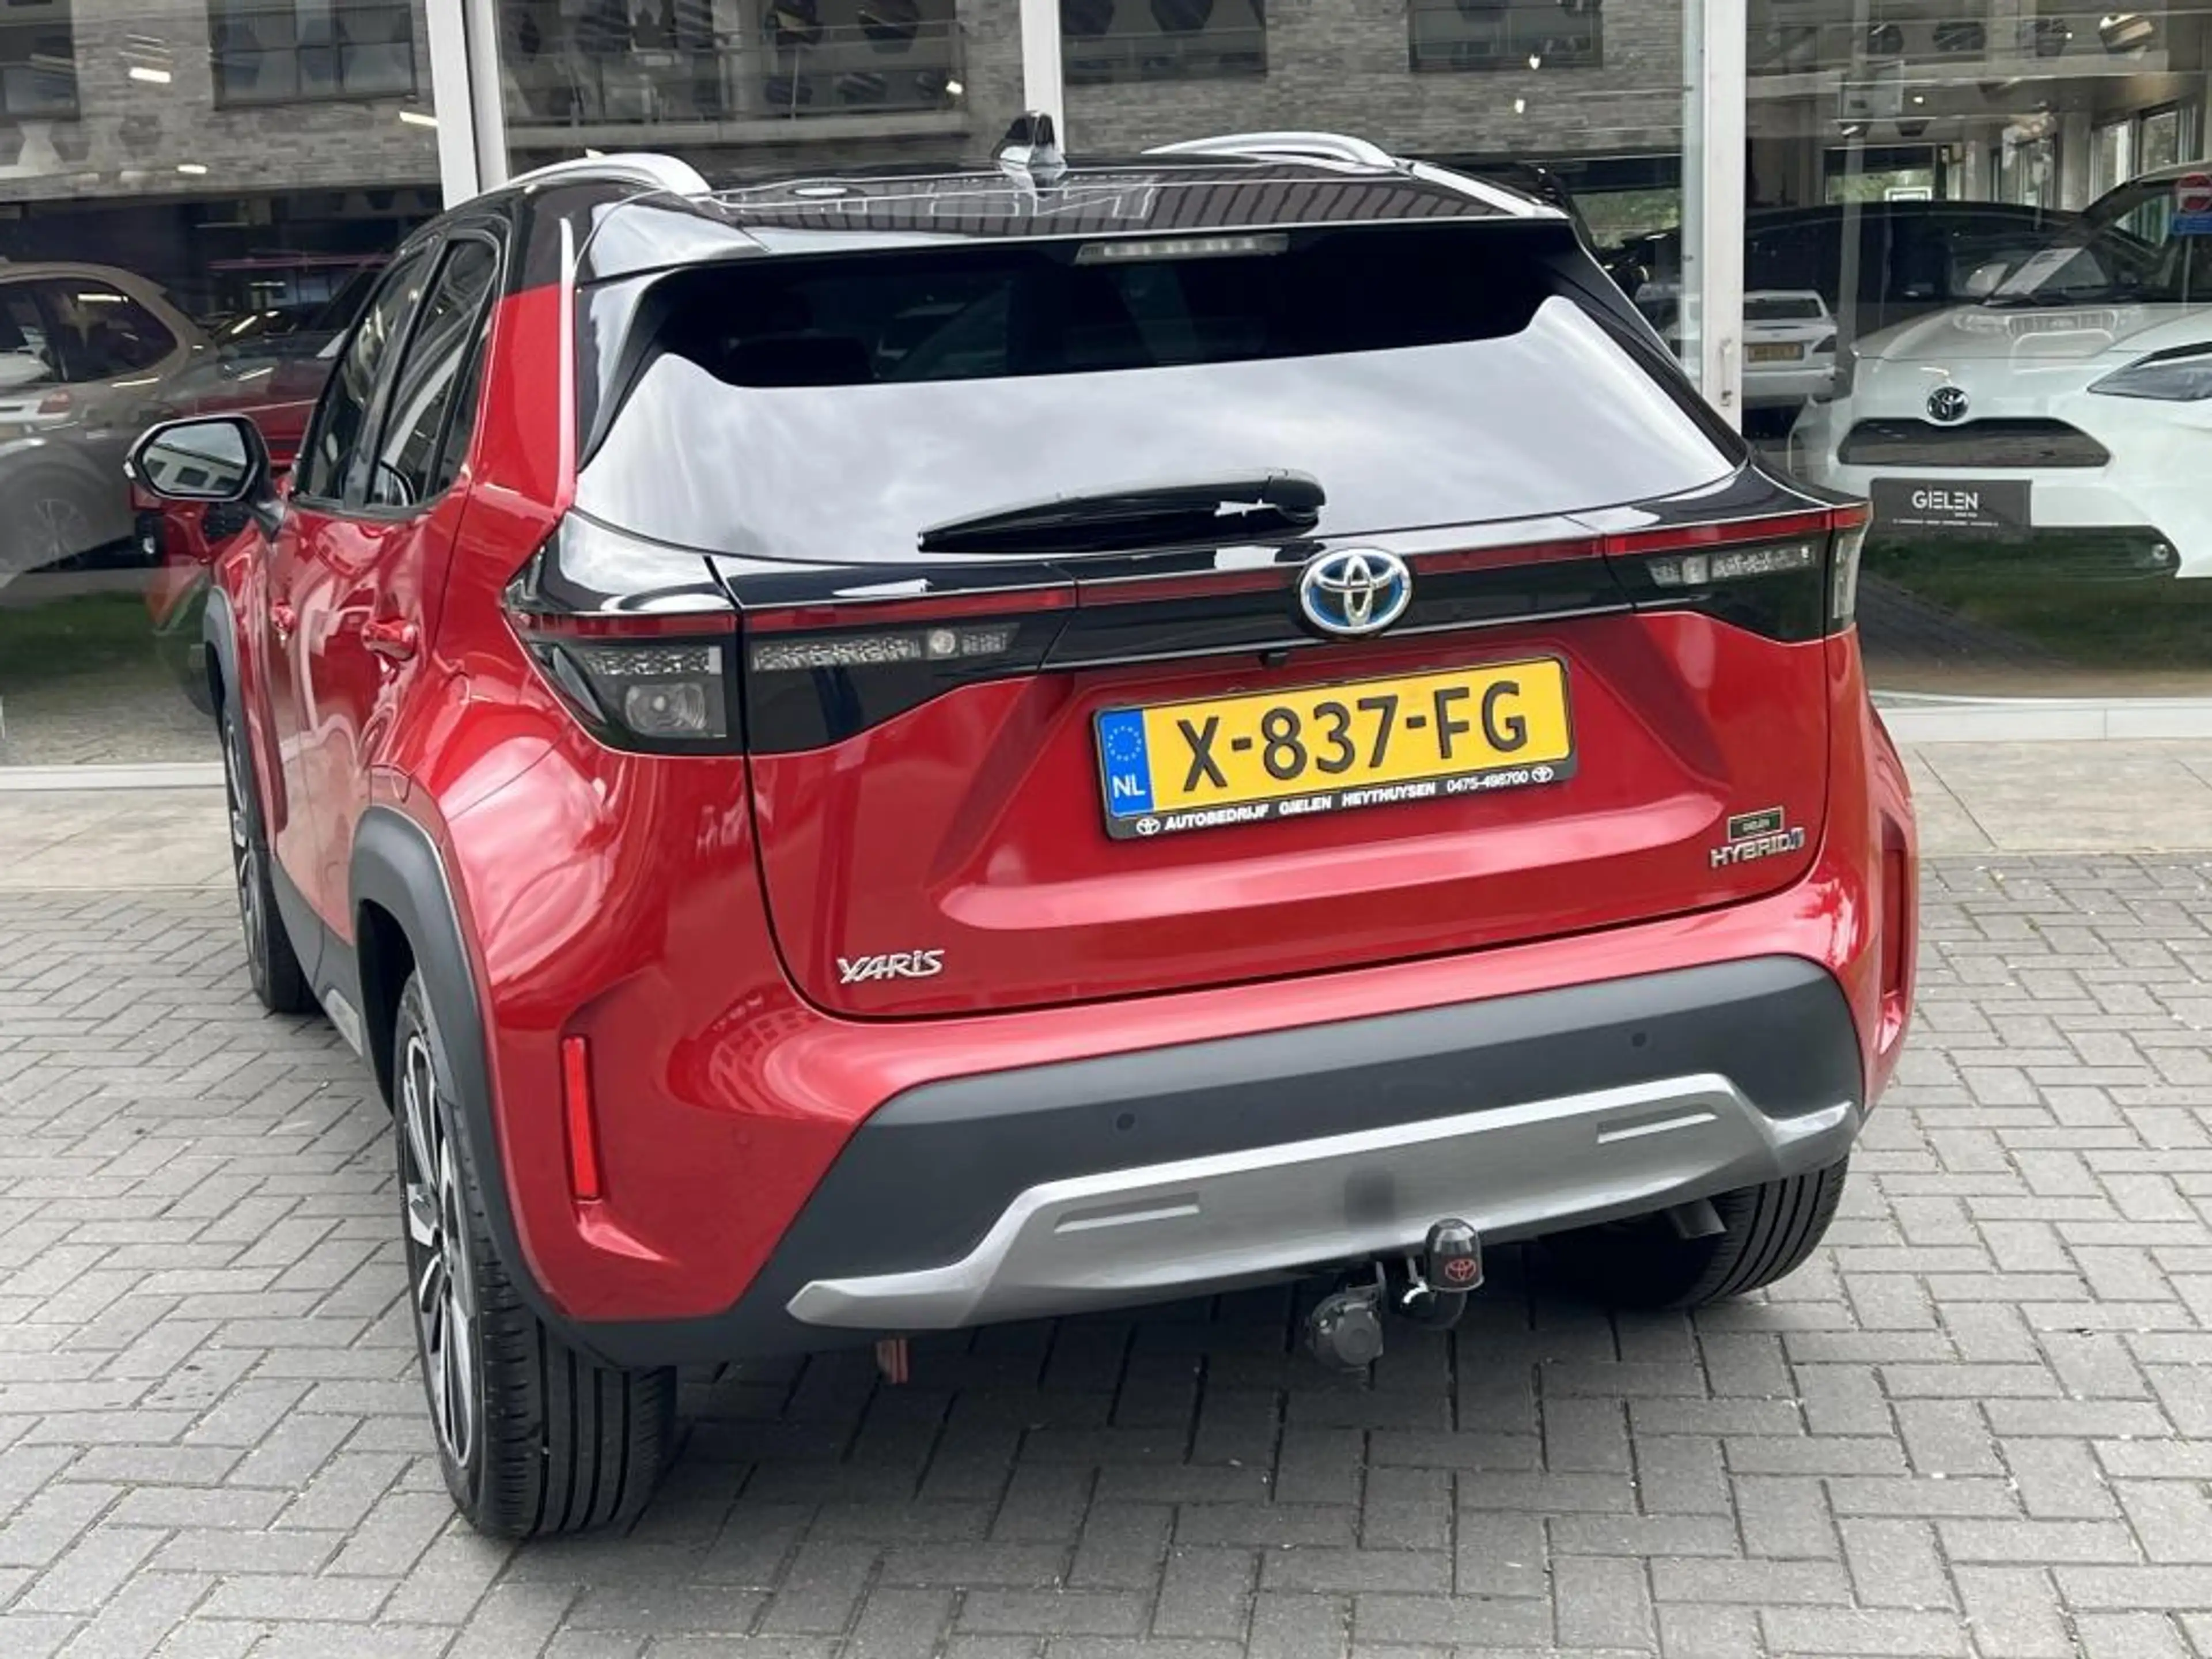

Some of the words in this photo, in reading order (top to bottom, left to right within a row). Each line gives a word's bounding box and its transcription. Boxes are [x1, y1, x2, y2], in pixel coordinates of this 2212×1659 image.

[1911, 490, 1979, 509] GIELEN
[1176, 680, 1528, 792] X-837-FG
[1112, 772, 1146, 798] NL
[1164, 804, 1270, 831] AUTOBEDRIJF
[1341, 782, 1436, 806] HEYTHUYSEN
[1710, 834, 1791, 869] HYBRID
